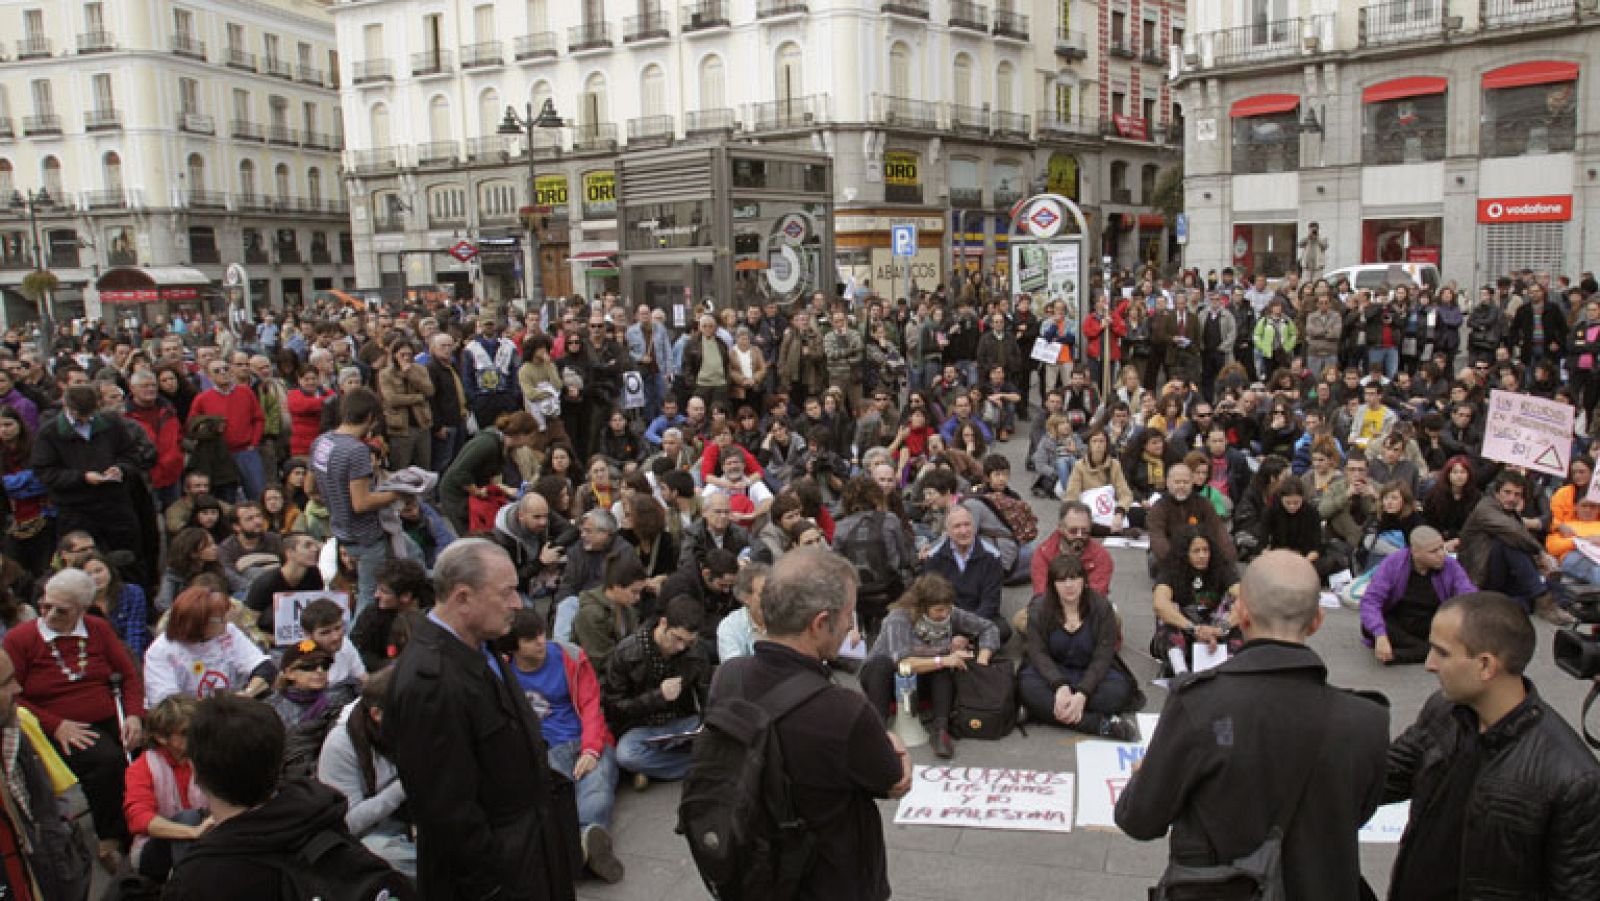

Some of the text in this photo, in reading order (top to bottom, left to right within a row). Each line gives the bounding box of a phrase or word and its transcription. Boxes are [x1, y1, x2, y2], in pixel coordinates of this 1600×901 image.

[885, 165, 916, 178] ORO
[535, 188, 567, 205] ORO
[1506, 203, 1563, 216] vodafone
[895, 229, 909, 254] P
[877, 262, 936, 280] ABACOS
[901, 807, 932, 819] LA
